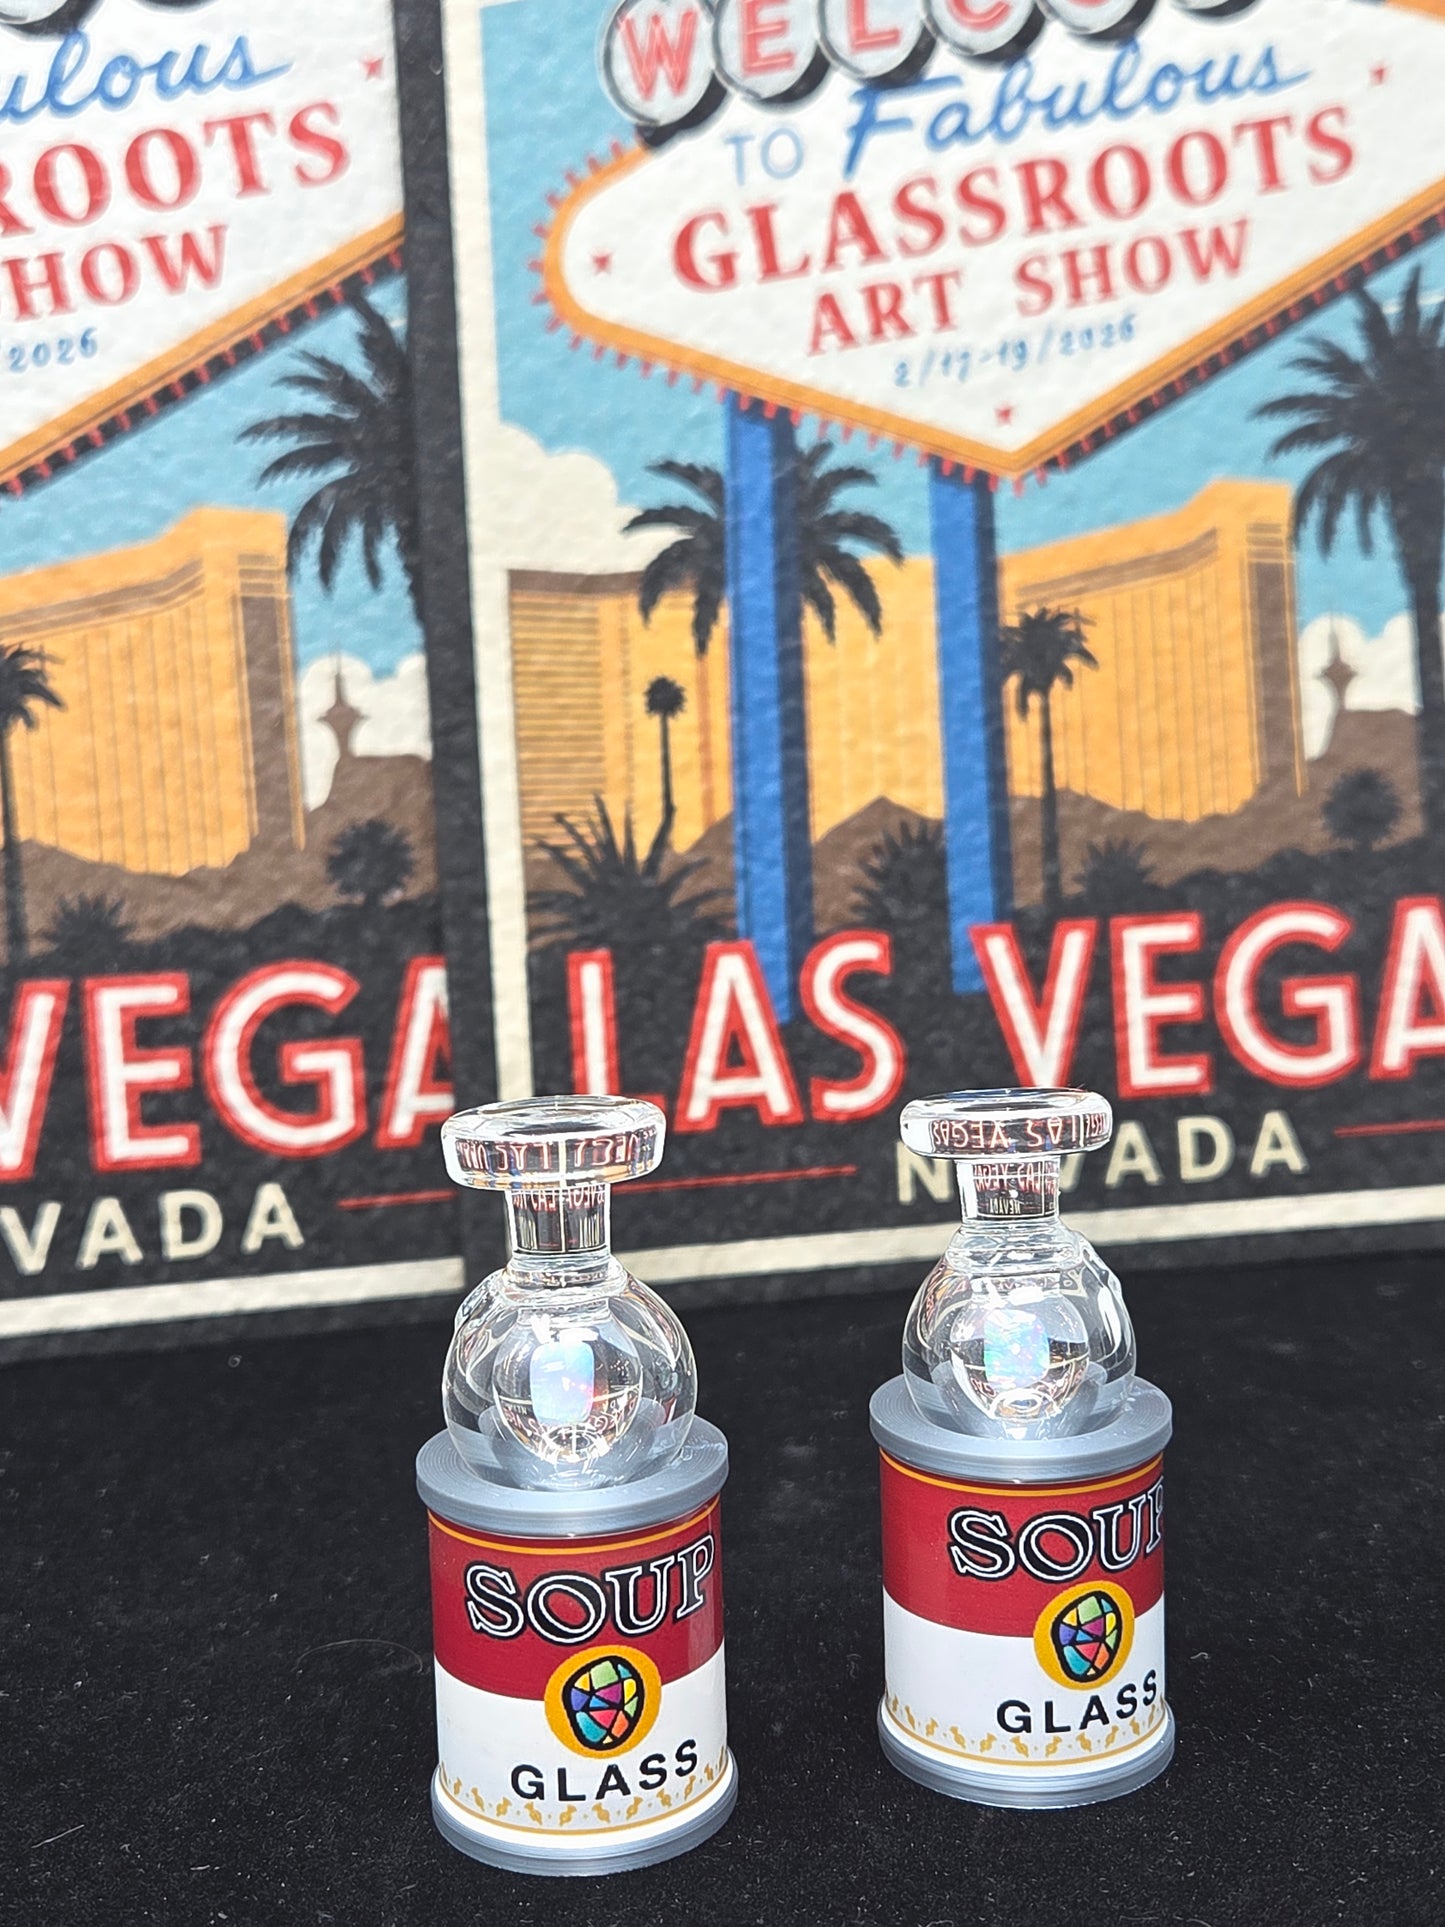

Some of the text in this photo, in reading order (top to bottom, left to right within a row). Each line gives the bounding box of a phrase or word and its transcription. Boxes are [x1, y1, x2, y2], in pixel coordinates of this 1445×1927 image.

[722, 37, 1310, 186] TO Fabulous
[672, 106, 1354, 293] GLASSROOTS
[2, 224, 228, 321] HOW
[808, 218, 1249, 356] ART SHOW
[8, 327, 98, 373] 2026
[566, 895, 1445, 1132] LAS VEGA
[897, 1110, 1309, 1202] NADA
[0, 1183, 304, 1276] VADA
[464, 1533, 717, 1648] SOUP
[996, 1669, 1158, 1734] GLASS
[510, 1739, 699, 1801] GLASS
